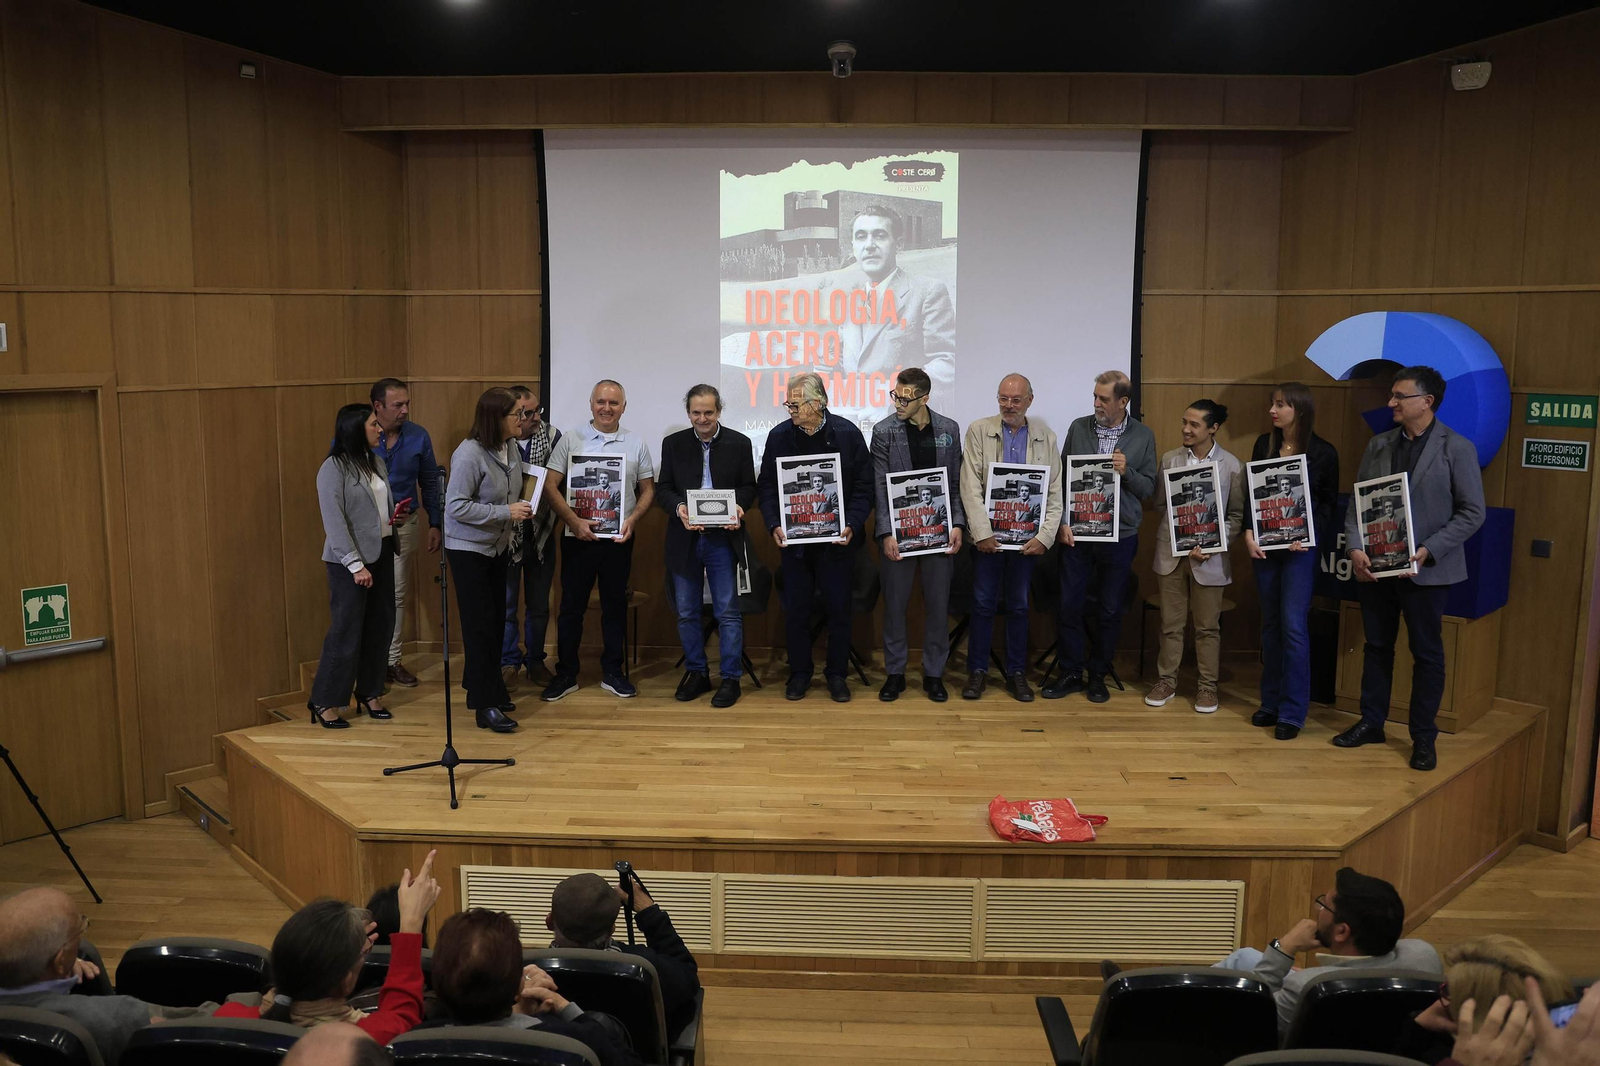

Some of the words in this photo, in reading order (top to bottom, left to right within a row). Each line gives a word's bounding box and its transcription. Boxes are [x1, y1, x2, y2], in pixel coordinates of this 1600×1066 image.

[891, 168, 915, 177] COSTE
[745, 281, 908, 330] IDEOLOGÍA,
[745, 331, 841, 367] ACERO
[744, 371, 762, 408] Y
[1530, 402, 1593, 419] SALIDA
[745, 420, 785, 431] MAN
[1529, 443, 1553, 453] AFORO
[1554, 445, 1583, 455] EDIFICIO
[1530, 454, 1542, 463] 215
[1543, 455, 1580, 466] PERSONAS
[29, 629, 50, 637] EMPUJAR
